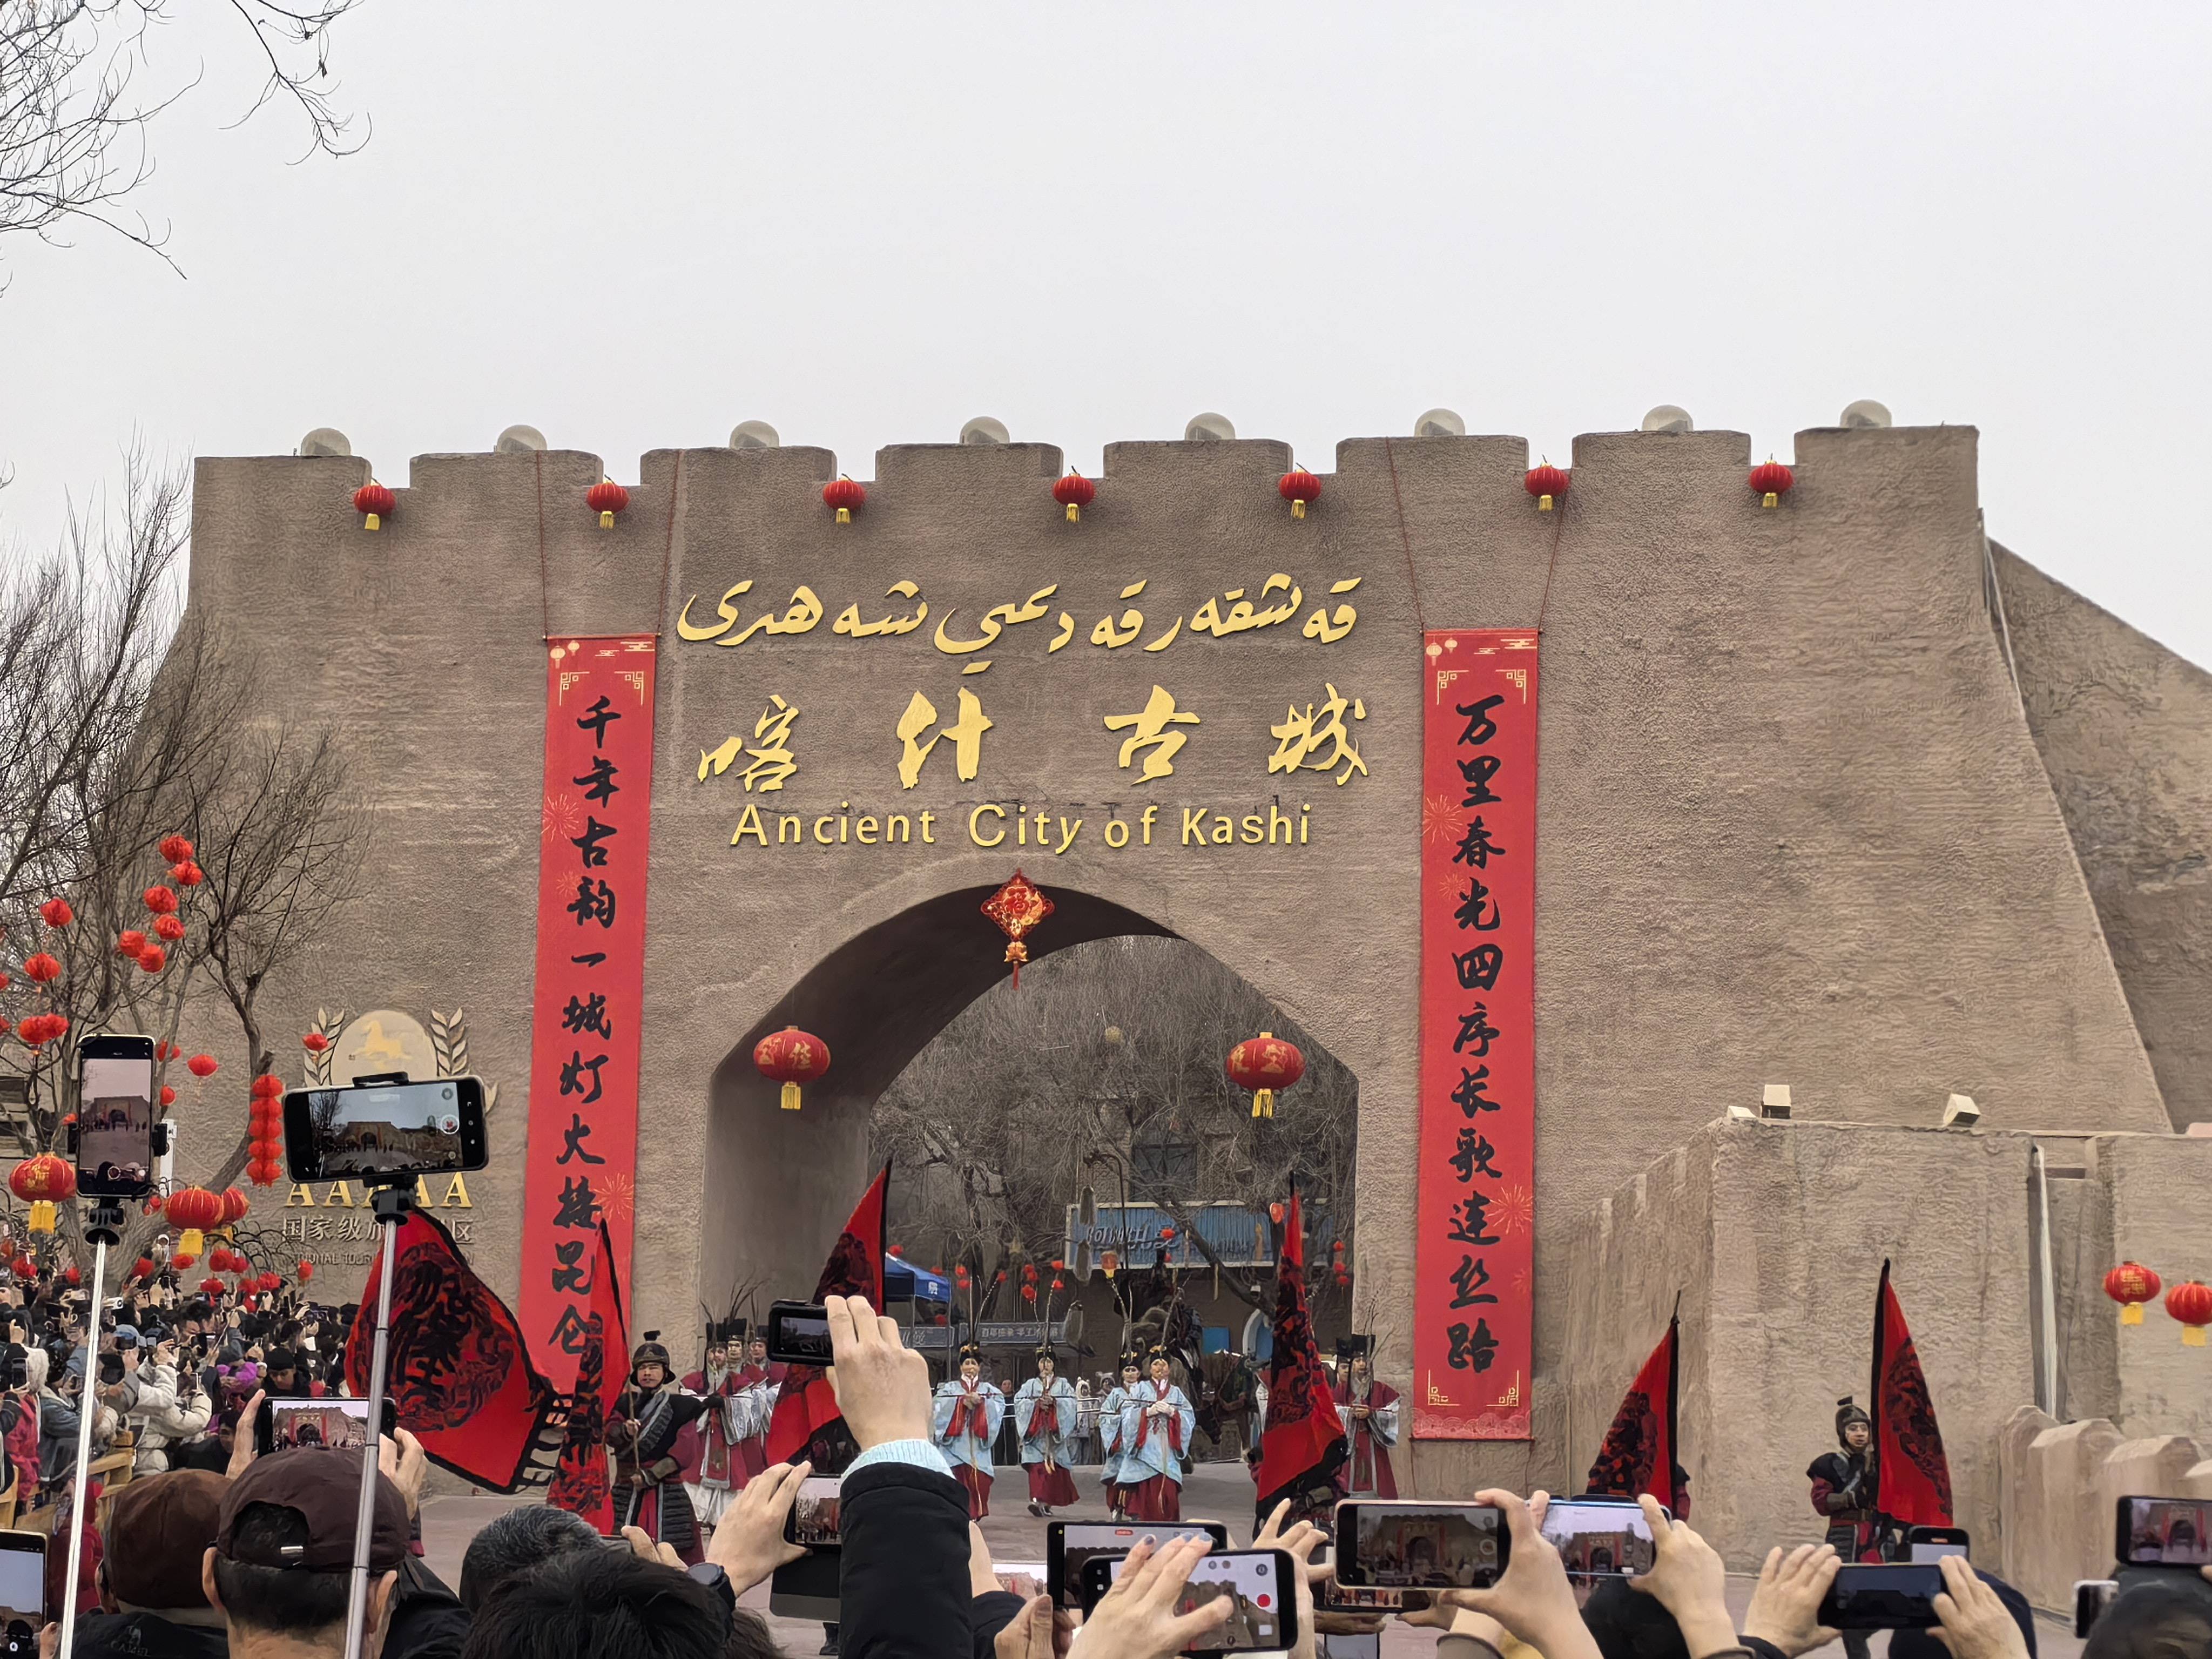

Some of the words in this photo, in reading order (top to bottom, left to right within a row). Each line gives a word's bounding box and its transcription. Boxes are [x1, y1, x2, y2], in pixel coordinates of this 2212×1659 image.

[699, 684, 1368, 792] 喀什古城
[730, 801, 936, 846] Ancient
[968, 805, 1083, 854] City
[1104, 805, 1158, 847] of
[1182, 803, 1311, 845] Kashi
